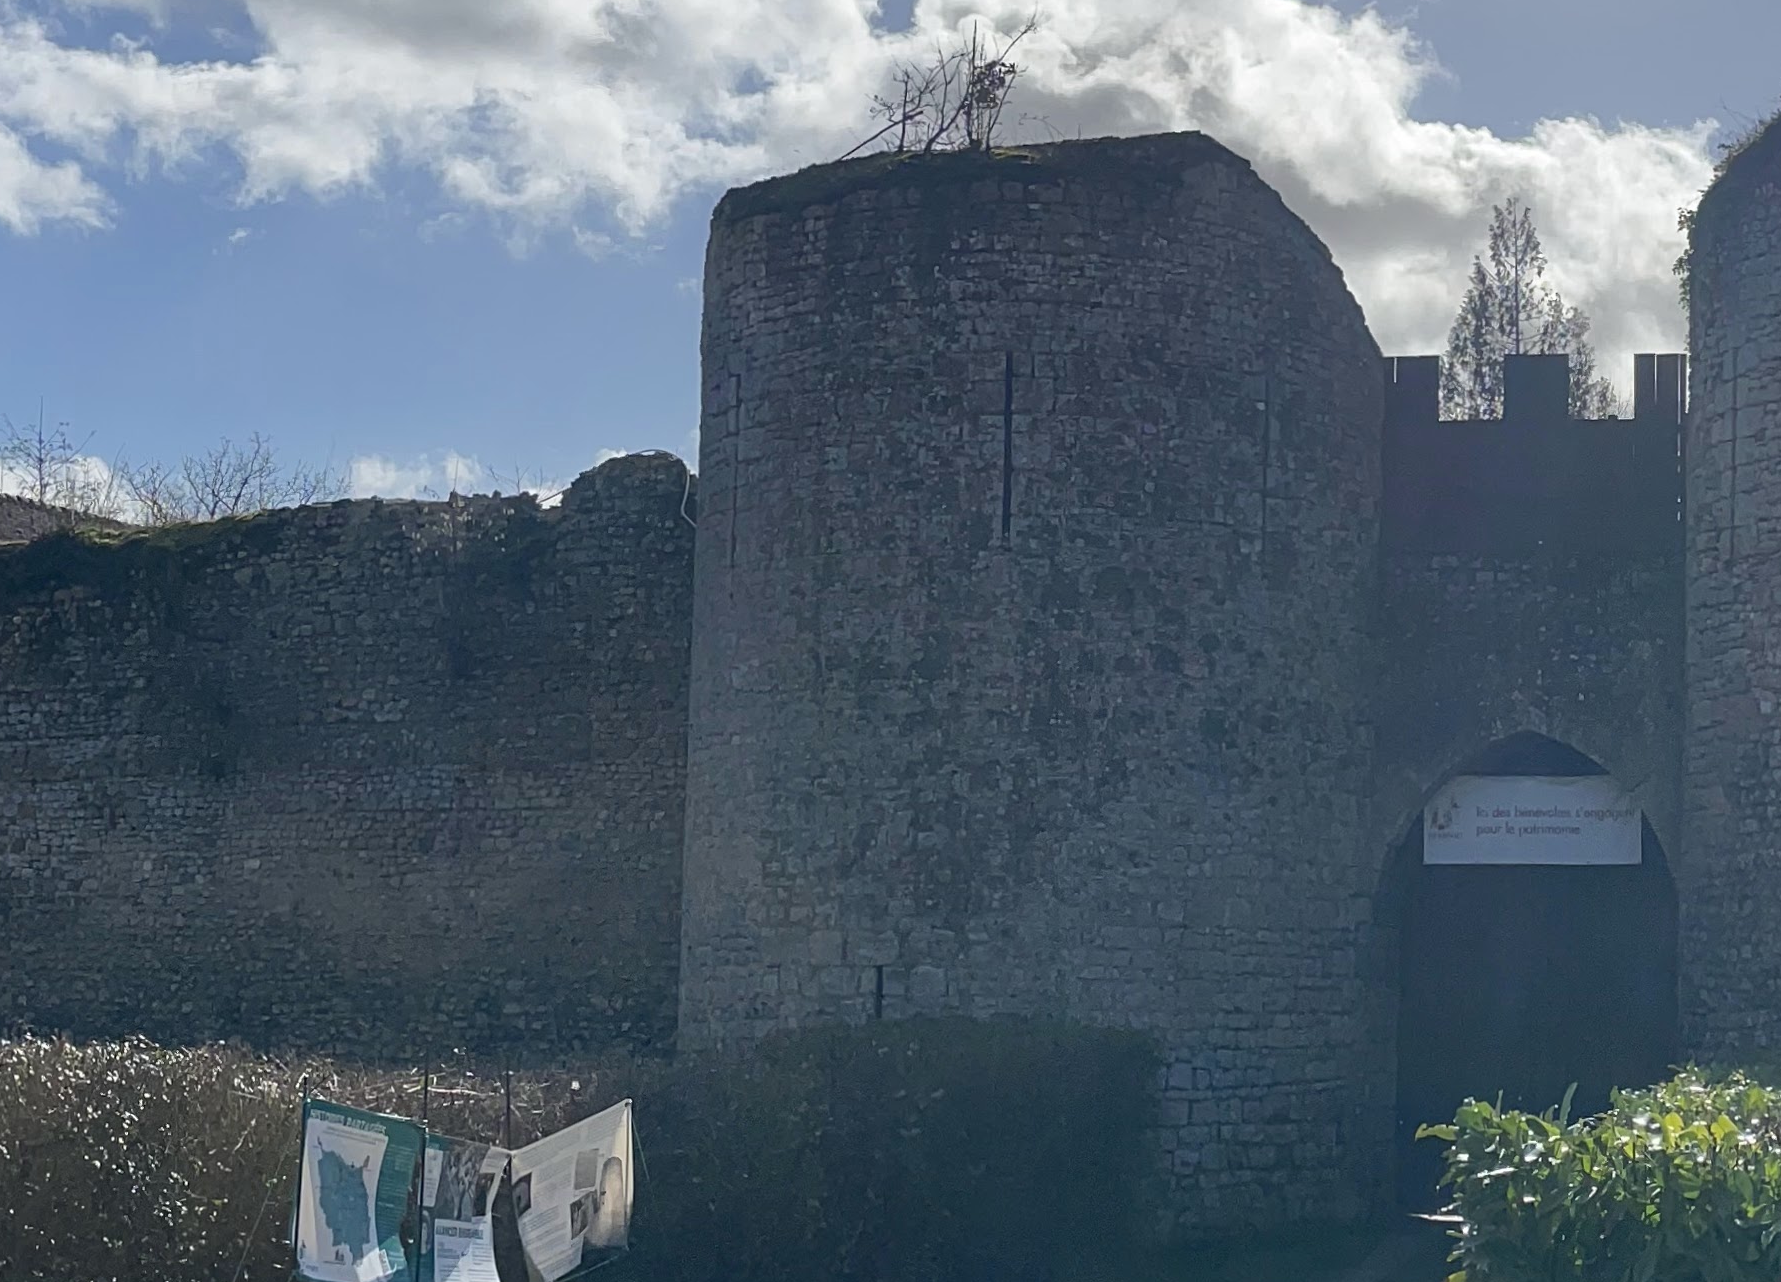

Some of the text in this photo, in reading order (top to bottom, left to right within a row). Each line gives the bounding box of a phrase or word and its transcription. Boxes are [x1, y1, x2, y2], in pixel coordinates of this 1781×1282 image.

[1492, 806, 1511, 818] des
[1476, 825, 1503, 837] pour
[1505, 822, 1515, 834] le
